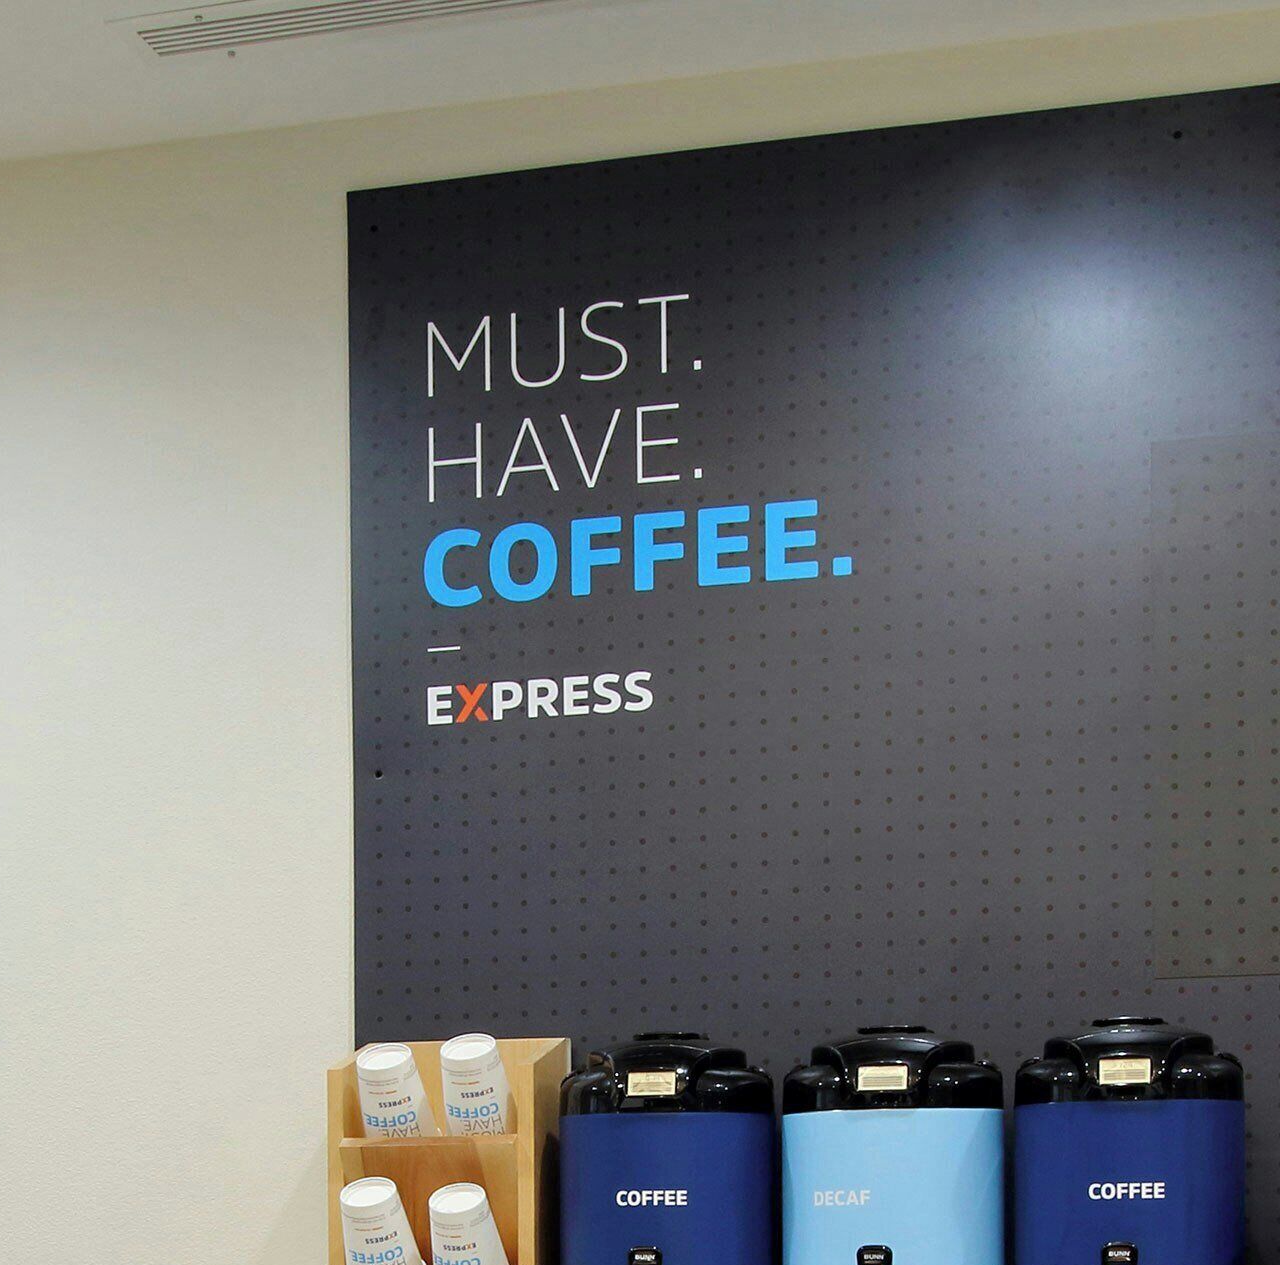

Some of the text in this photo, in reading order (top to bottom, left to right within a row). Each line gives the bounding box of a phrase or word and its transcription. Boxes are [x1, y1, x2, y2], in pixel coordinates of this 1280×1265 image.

[427, 294, 703, 397] MUST.
[428, 403, 703, 503] HAVE.
[423, 499, 853, 608] COFFEE.
[427, 671, 654, 725] EXPRESS
[460, 1086, 494, 1098] EXPRESS
[378, 1095, 412, 1108] EXPRESS
[616, 1190, 688, 1206] COFFEE
[814, 1190, 871, 1206] DECAF
[1088, 1182, 1165, 1200] COFFEE
[364, 1230, 398, 1244] EXPRESS
[442, 1242, 477, 1252] EXPRESS
